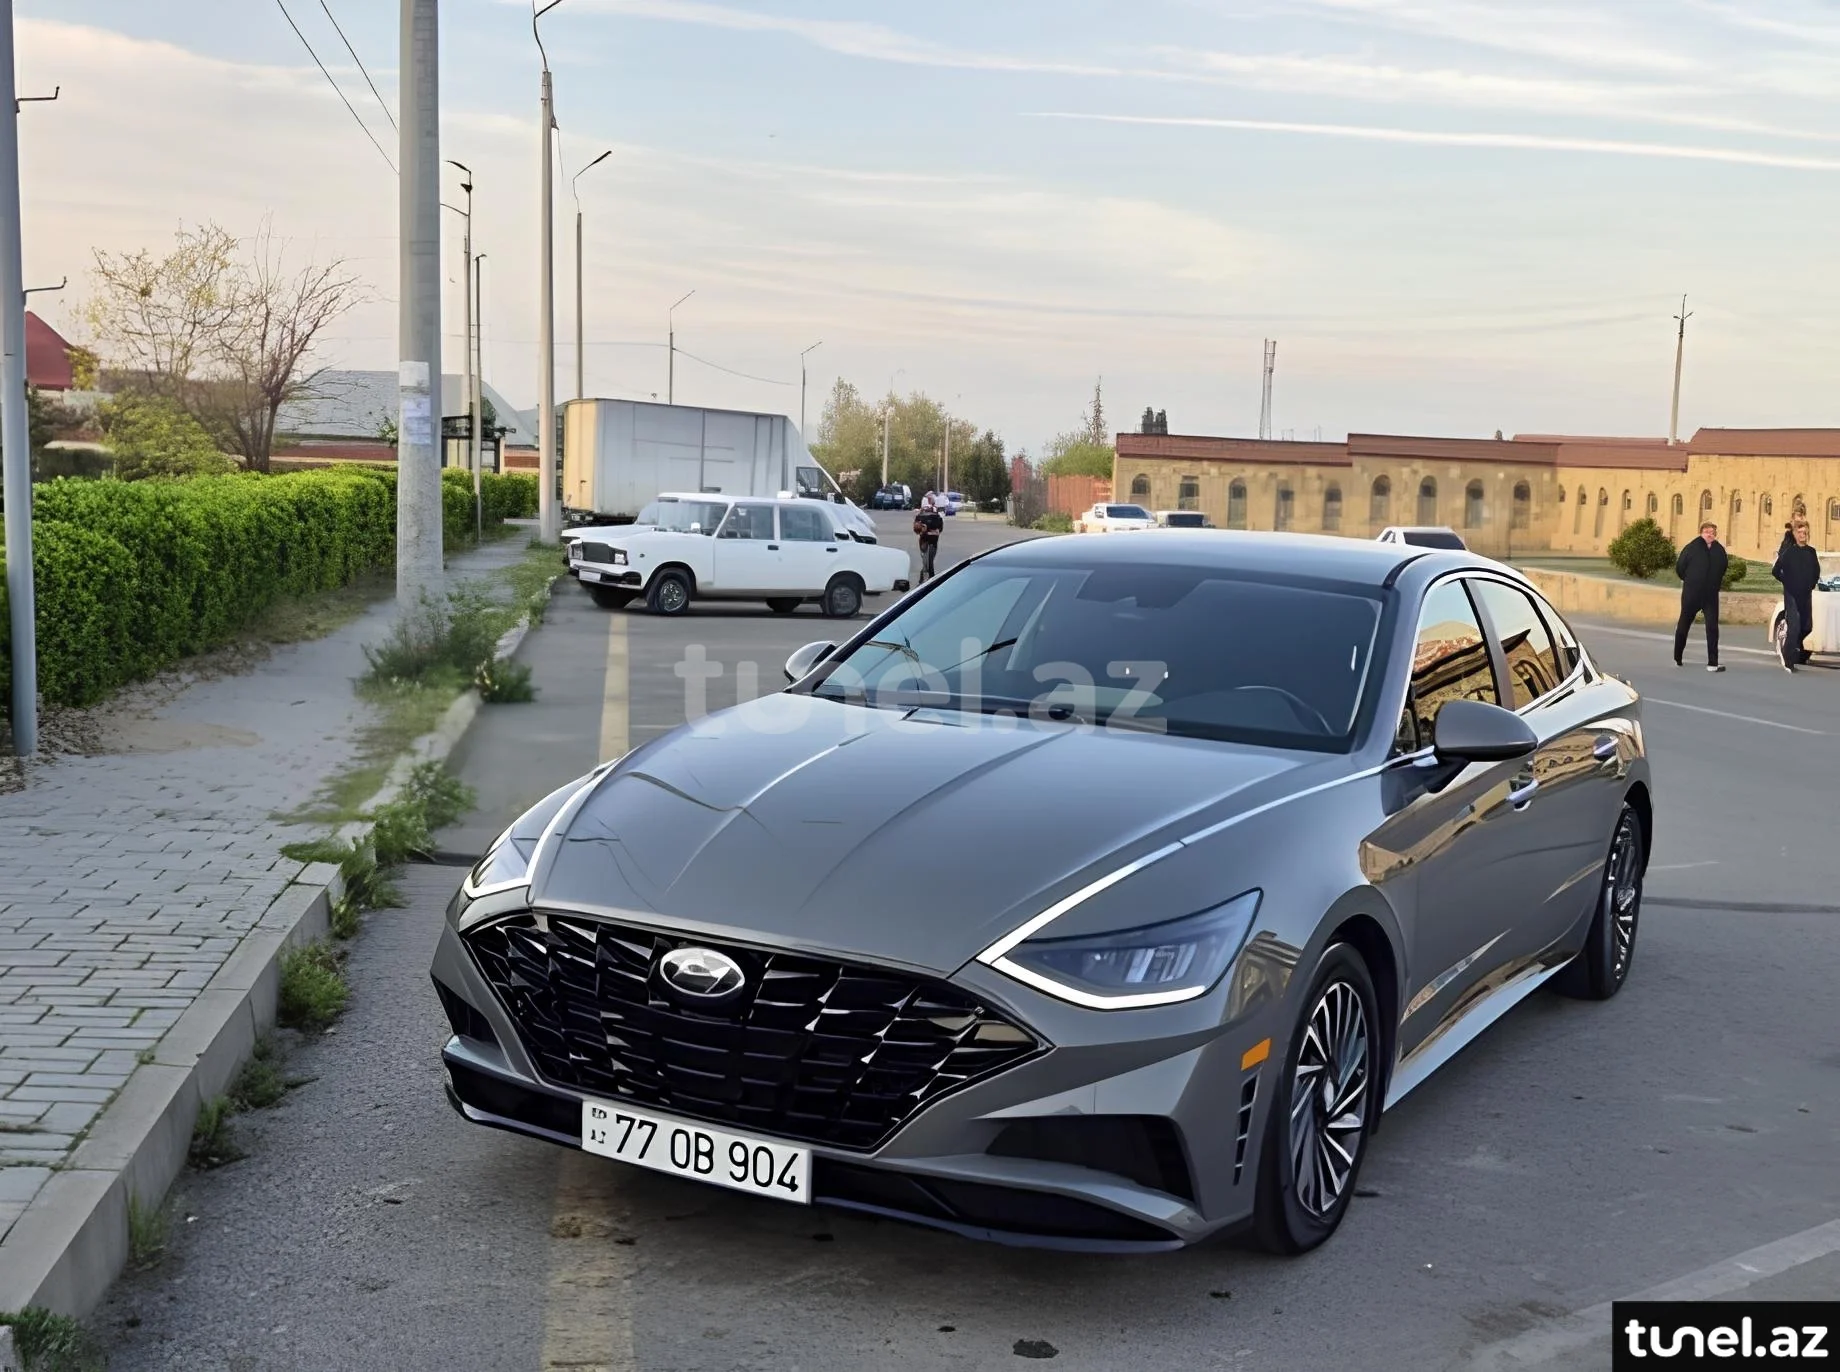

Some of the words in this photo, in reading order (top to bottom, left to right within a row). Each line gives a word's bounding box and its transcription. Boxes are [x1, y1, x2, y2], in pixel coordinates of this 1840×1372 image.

[616, 1114, 658, 1159] 77
[670, 1129, 714, 1175] OB
[728, 1141, 799, 1192] 904
